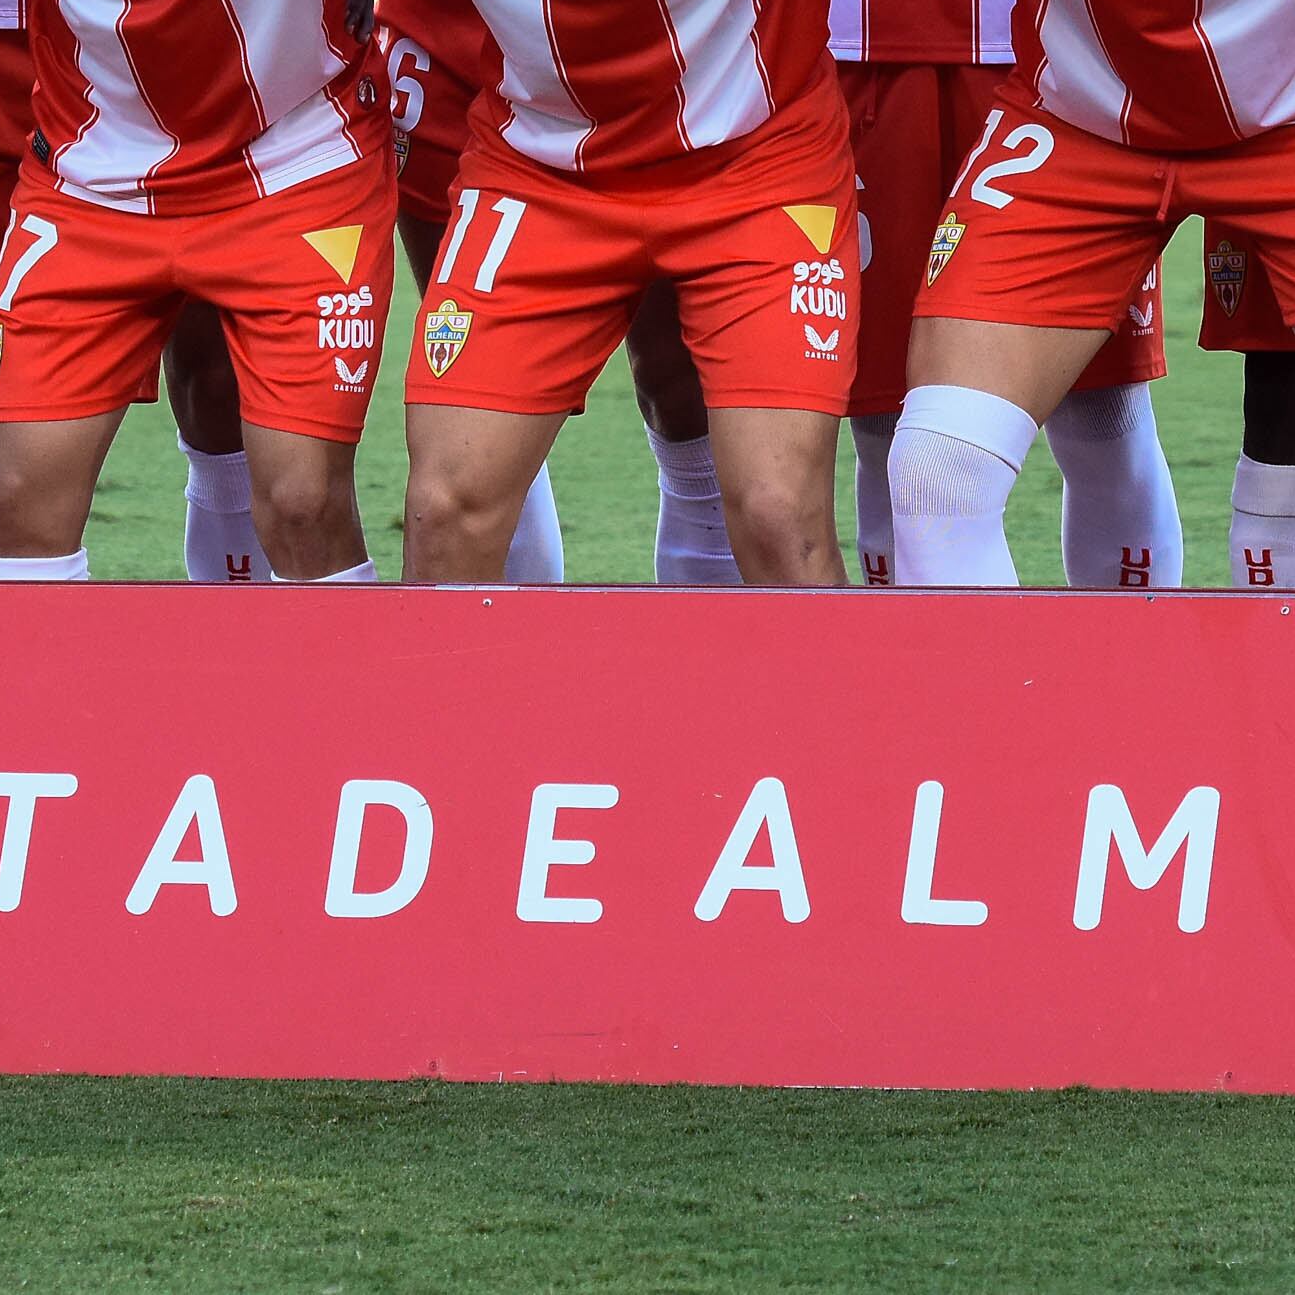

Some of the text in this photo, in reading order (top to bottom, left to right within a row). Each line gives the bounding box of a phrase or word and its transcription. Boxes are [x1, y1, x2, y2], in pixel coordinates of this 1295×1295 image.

[378, 26, 430, 132] 6
[949, 109, 1055, 209] 12
[436, 189, 527, 293] 11
[790, 284, 846, 320] KUDU
[318, 318, 374, 349] KUDU
[428, 332, 462, 340] ALMERIA
[226, 554, 251, 580] U
